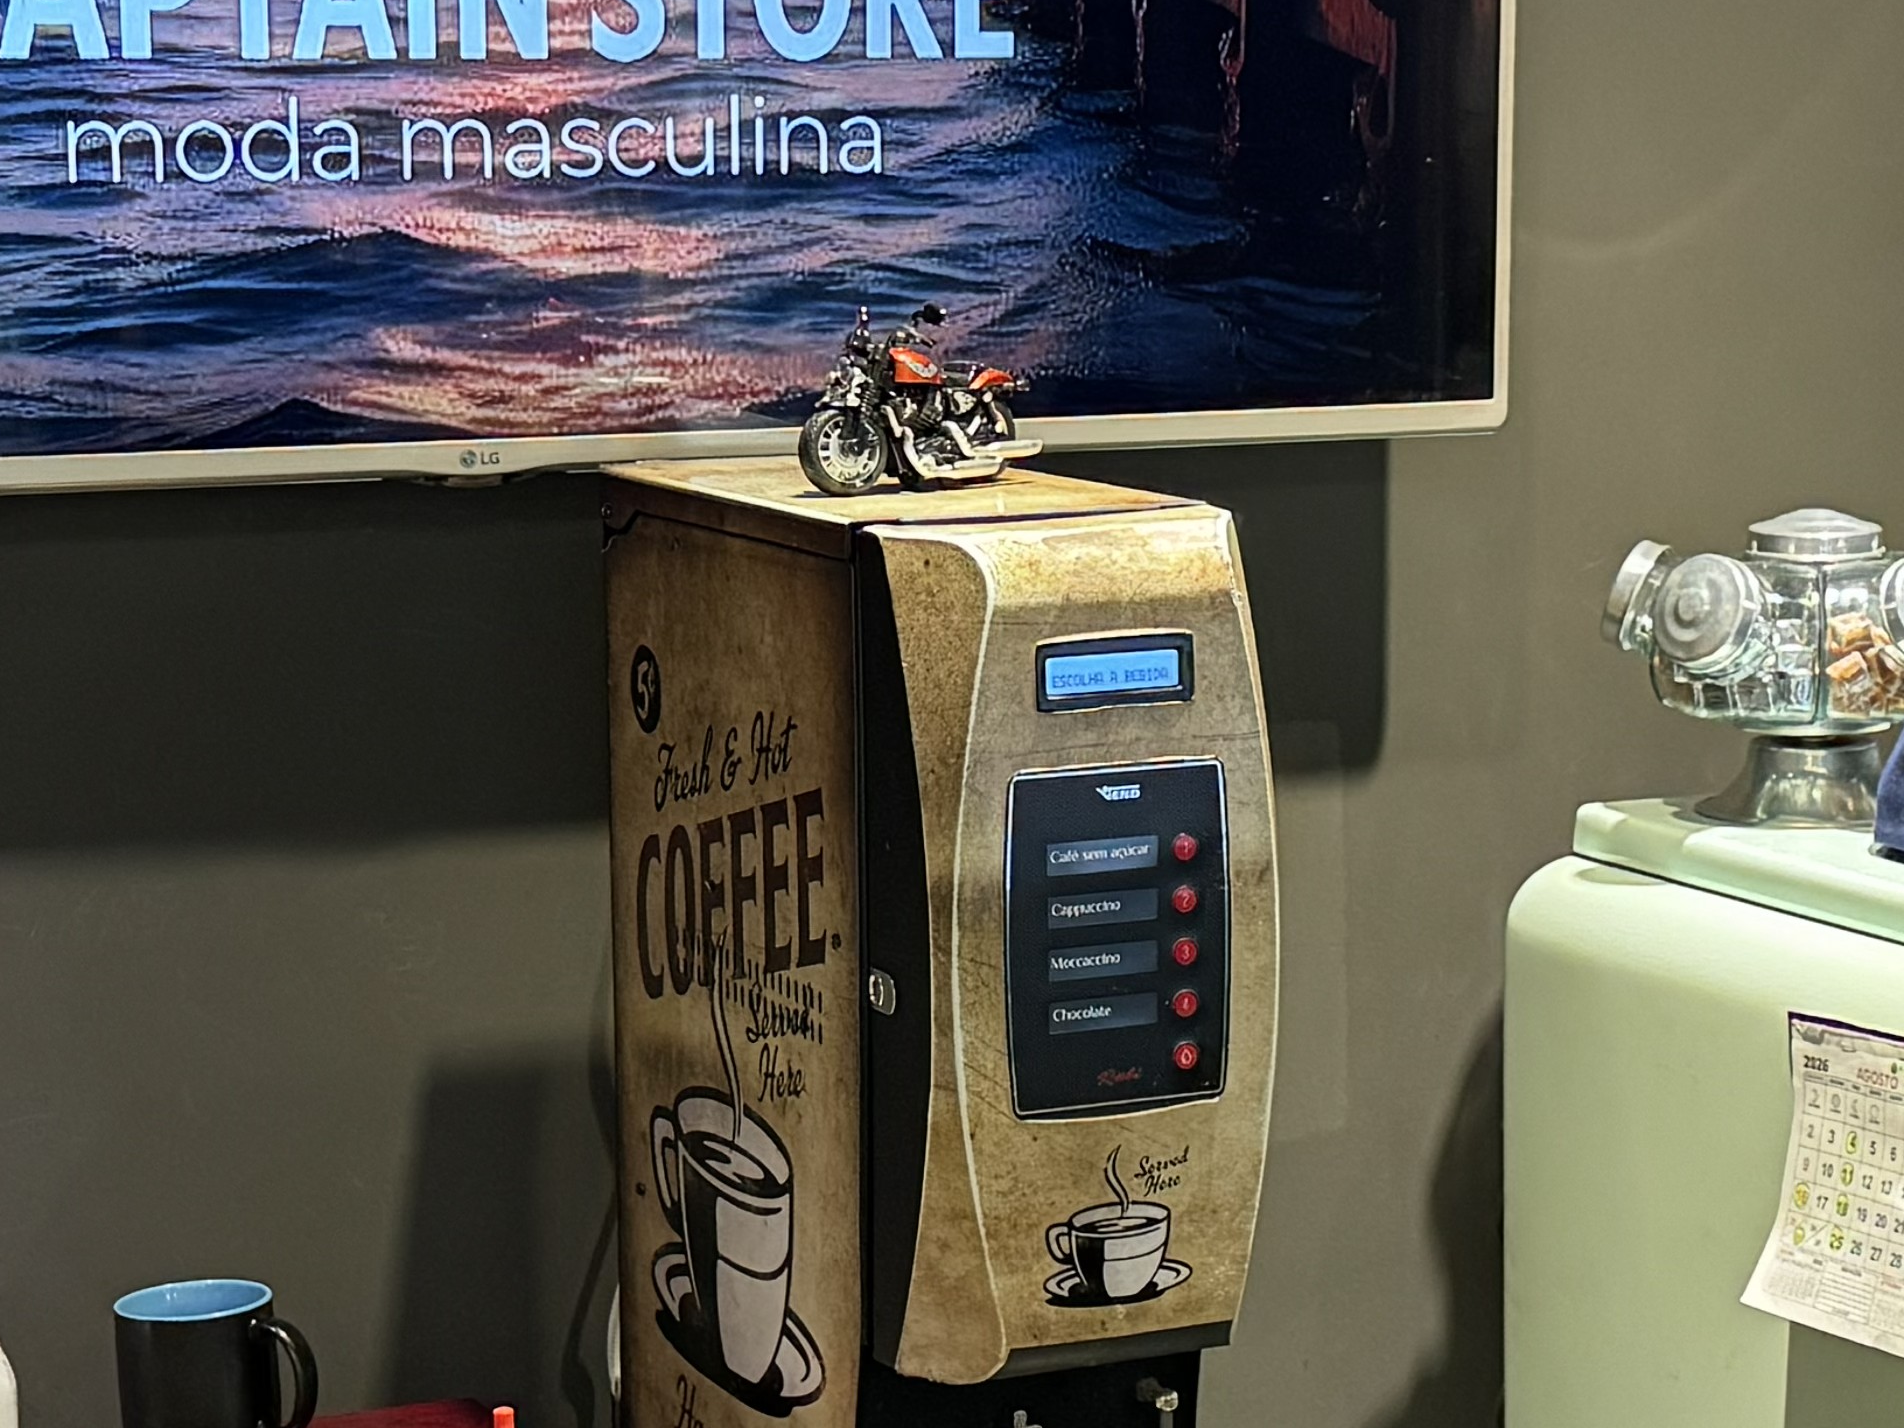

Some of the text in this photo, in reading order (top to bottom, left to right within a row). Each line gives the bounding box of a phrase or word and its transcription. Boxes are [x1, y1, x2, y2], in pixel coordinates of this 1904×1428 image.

[65, 94, 883, 184] moda masculina
[480, 451, 500, 465] LG
[1052, 667, 1170, 689] ESCOLHA A BEBIDA
[654, 711, 798, 812] Fresh & Hot
[1049, 849, 1079, 864] Café
[1082, 849, 1108, 861] sem
[637, 788, 826, 1000] COFFEE
[1051, 900, 1121, 918] Cappuccino
[1050, 953, 1121, 970] Moccaccino
[745, 979, 811, 1044] Served
[1052, 1005, 1112, 1022] Chocolate
[757, 1042, 806, 1103] Here
[1856, 1067, 1899, 1090] AGOSTO
[1807, 1124, 1815, 1139] 2
[1827, 1129, 1836, 1144] 3
[1869, 1140, 1877, 1156] 5
[1134, 1143, 1190, 1179] Served
[1143, 1173, 1181, 1198] Here
[1862, 1174, 1873, 1191] 12
[1817, 1195, 1829, 1210] 17
[1870, 1246, 1883, 1262] 27
